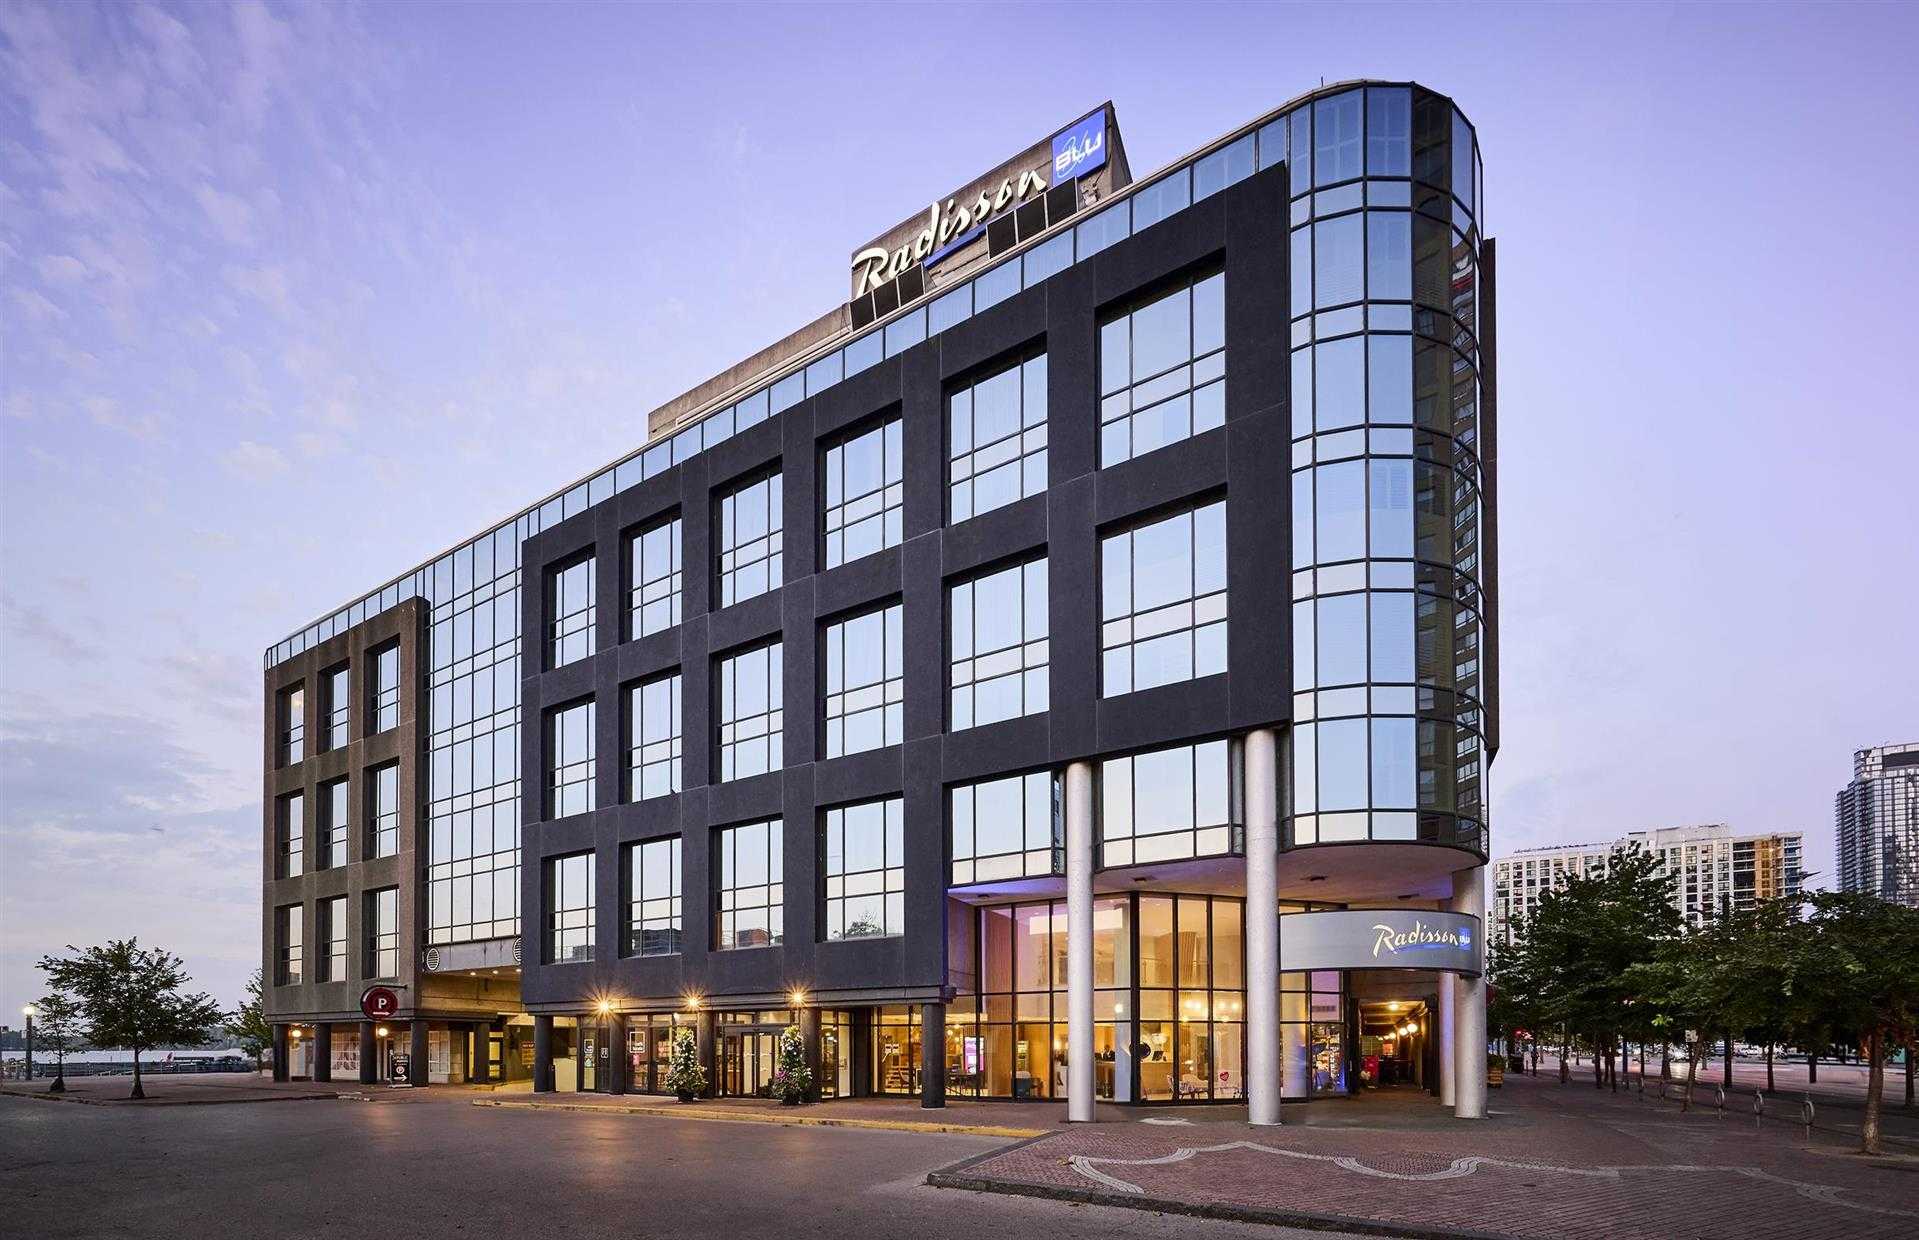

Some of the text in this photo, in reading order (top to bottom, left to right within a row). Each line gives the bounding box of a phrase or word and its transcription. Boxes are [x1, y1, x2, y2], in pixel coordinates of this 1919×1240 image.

[851, 169, 1048, 299] Radisson
[1372, 920, 1458, 957] Radisson
[378, 998, 387, 1009] P
